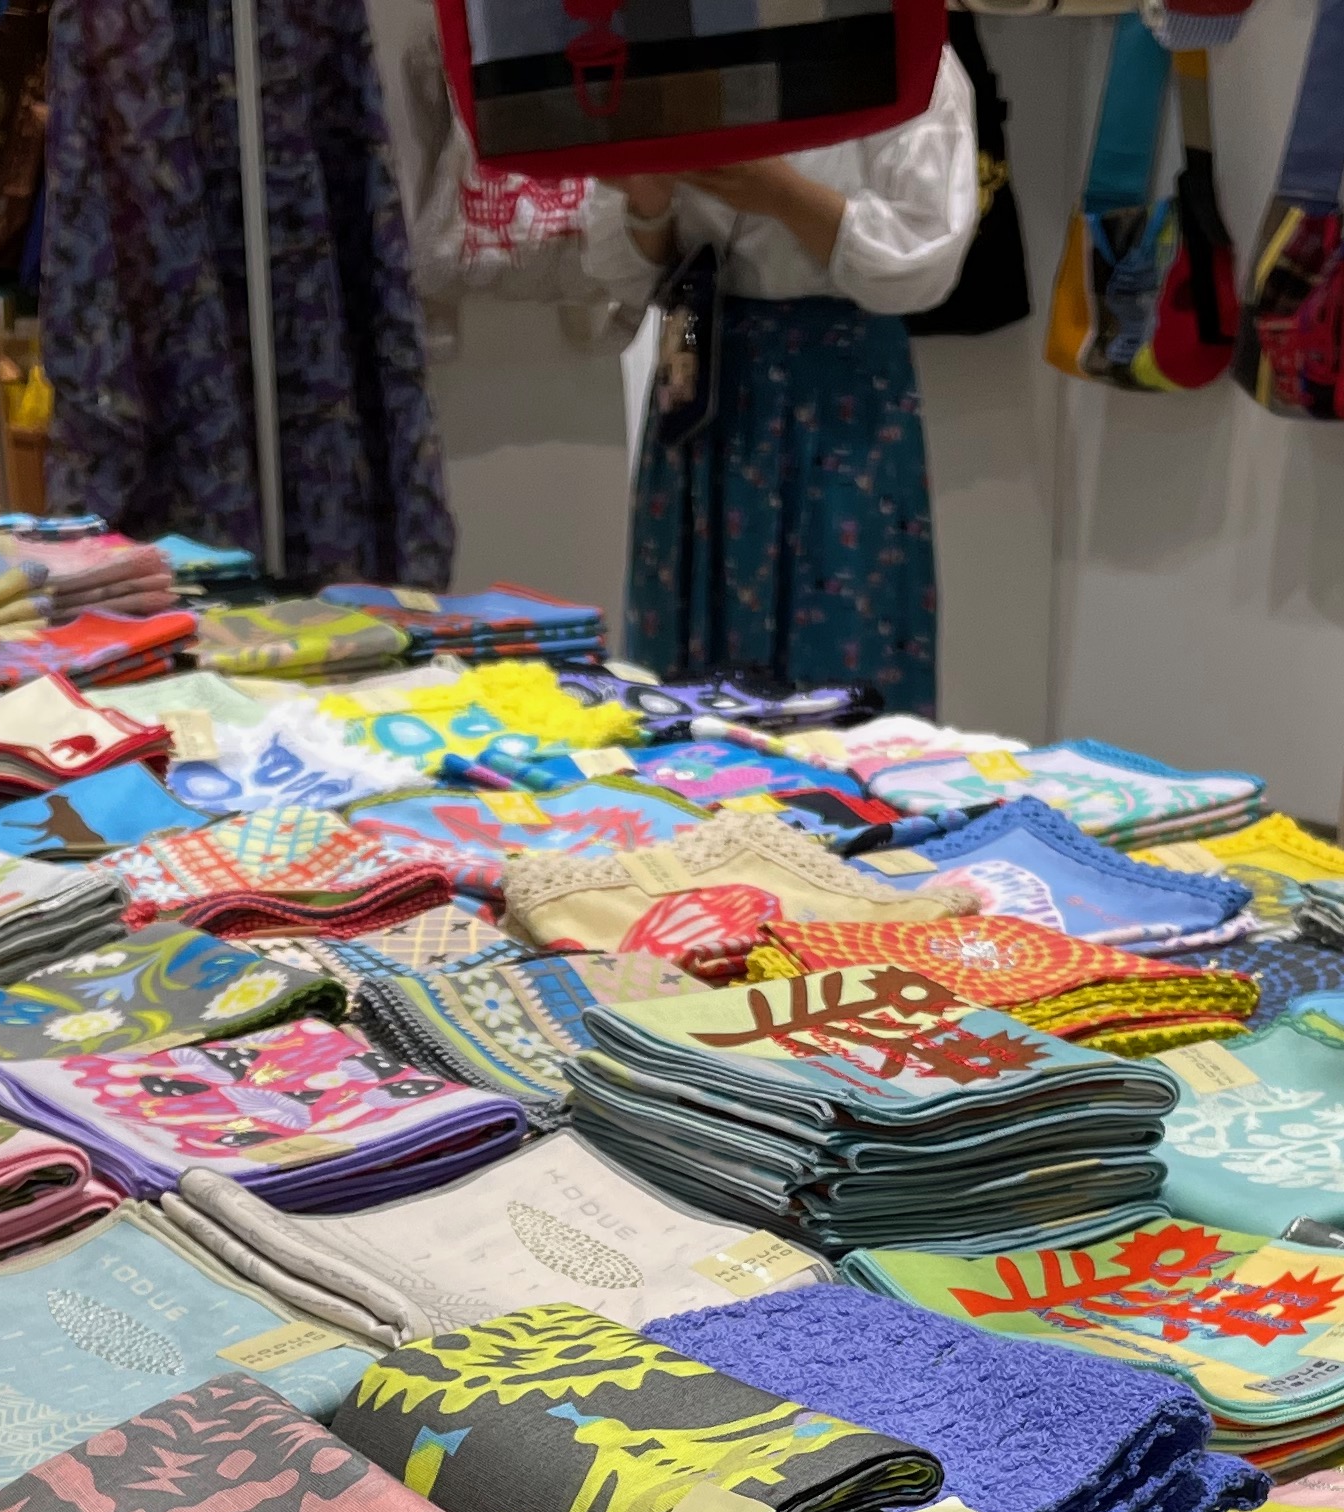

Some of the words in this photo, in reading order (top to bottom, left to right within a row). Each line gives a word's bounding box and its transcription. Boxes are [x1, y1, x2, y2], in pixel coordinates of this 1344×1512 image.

[545, 1167, 639, 1241] KODUE
[101, 1254, 190, 1322] KODUE
[239, 1330, 318, 1363] KODUE
[1259, 1359, 1328, 1389] KODUE
